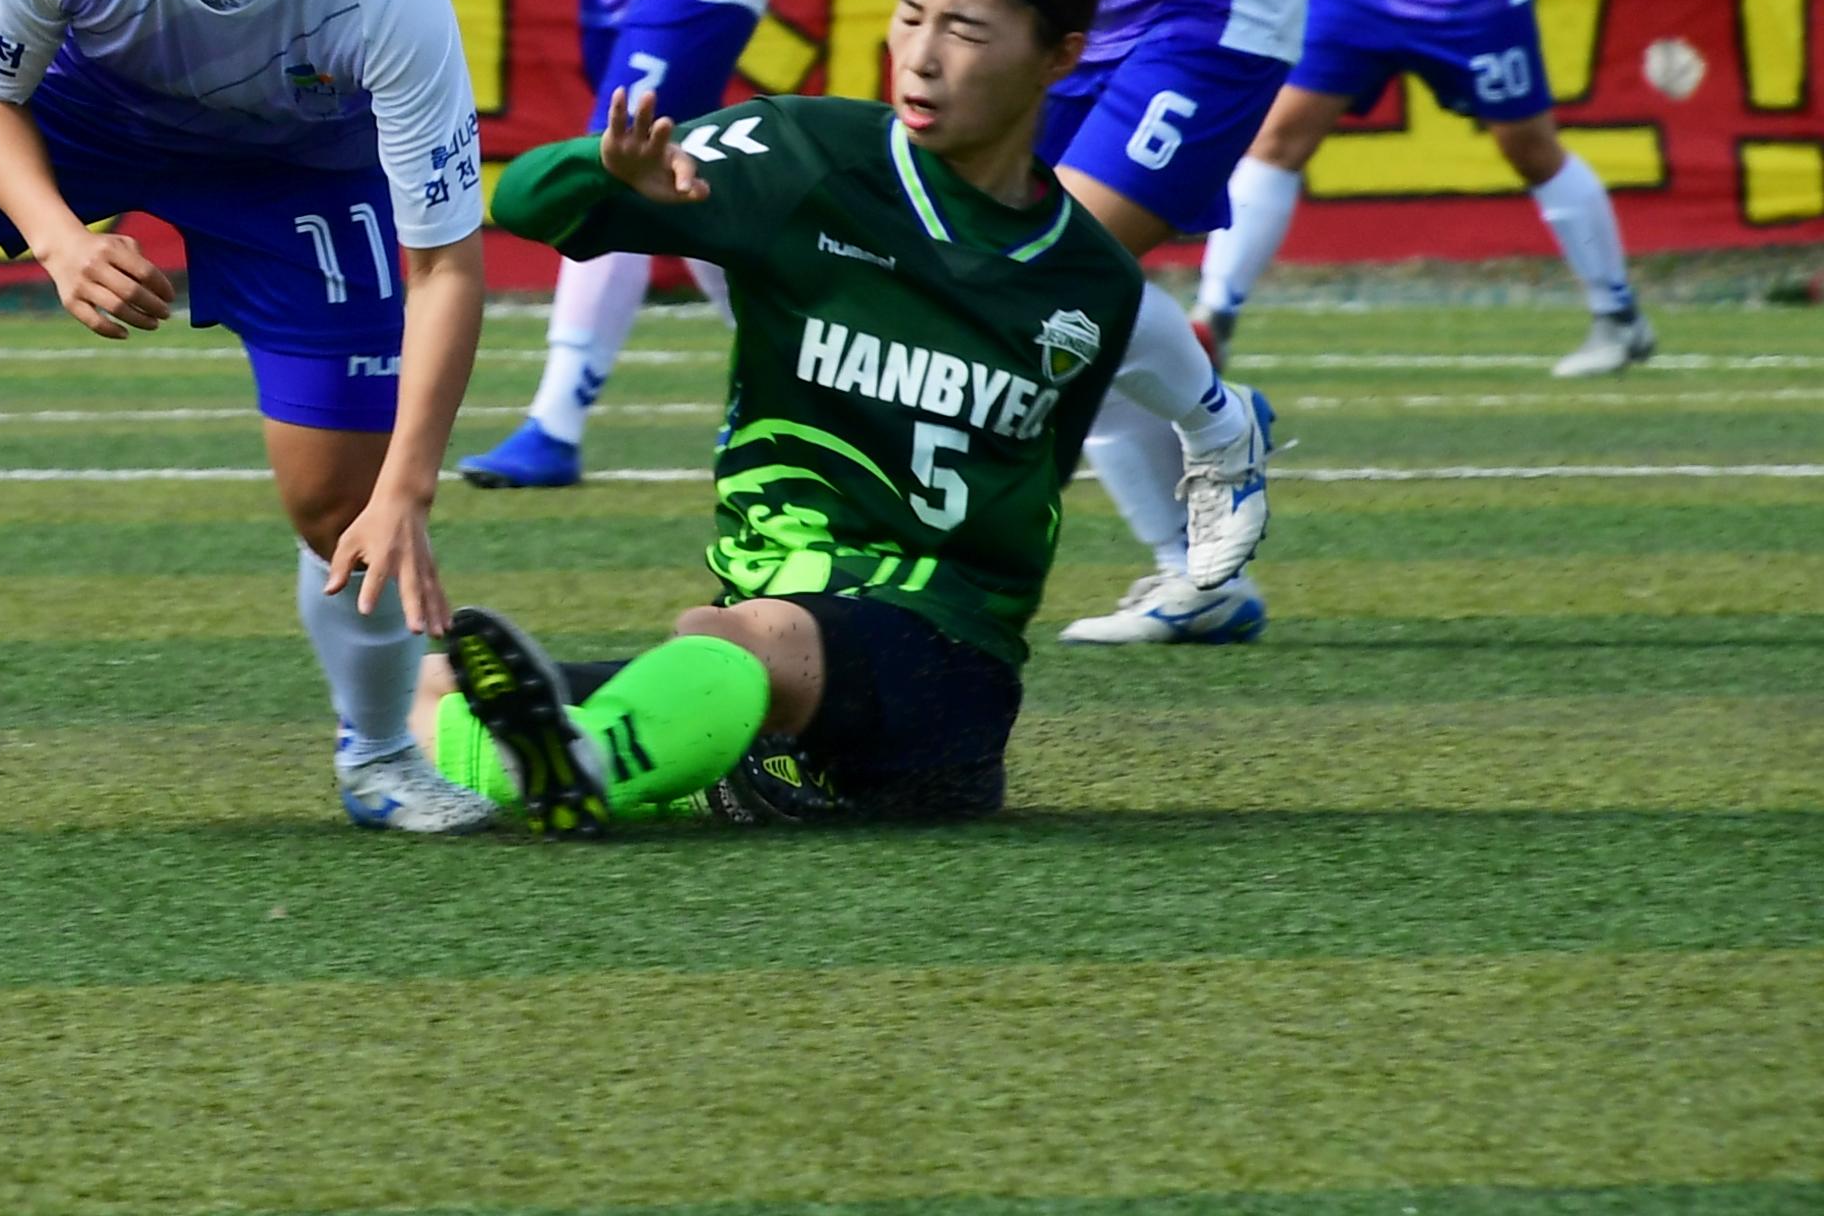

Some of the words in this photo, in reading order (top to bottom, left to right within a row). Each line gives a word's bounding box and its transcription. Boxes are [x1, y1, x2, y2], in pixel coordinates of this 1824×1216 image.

[1469, 47, 1530, 102] 20
[1126, 89, 1199, 171] 6
[294, 202, 393, 304] 11
[909, 420, 970, 533] 5
